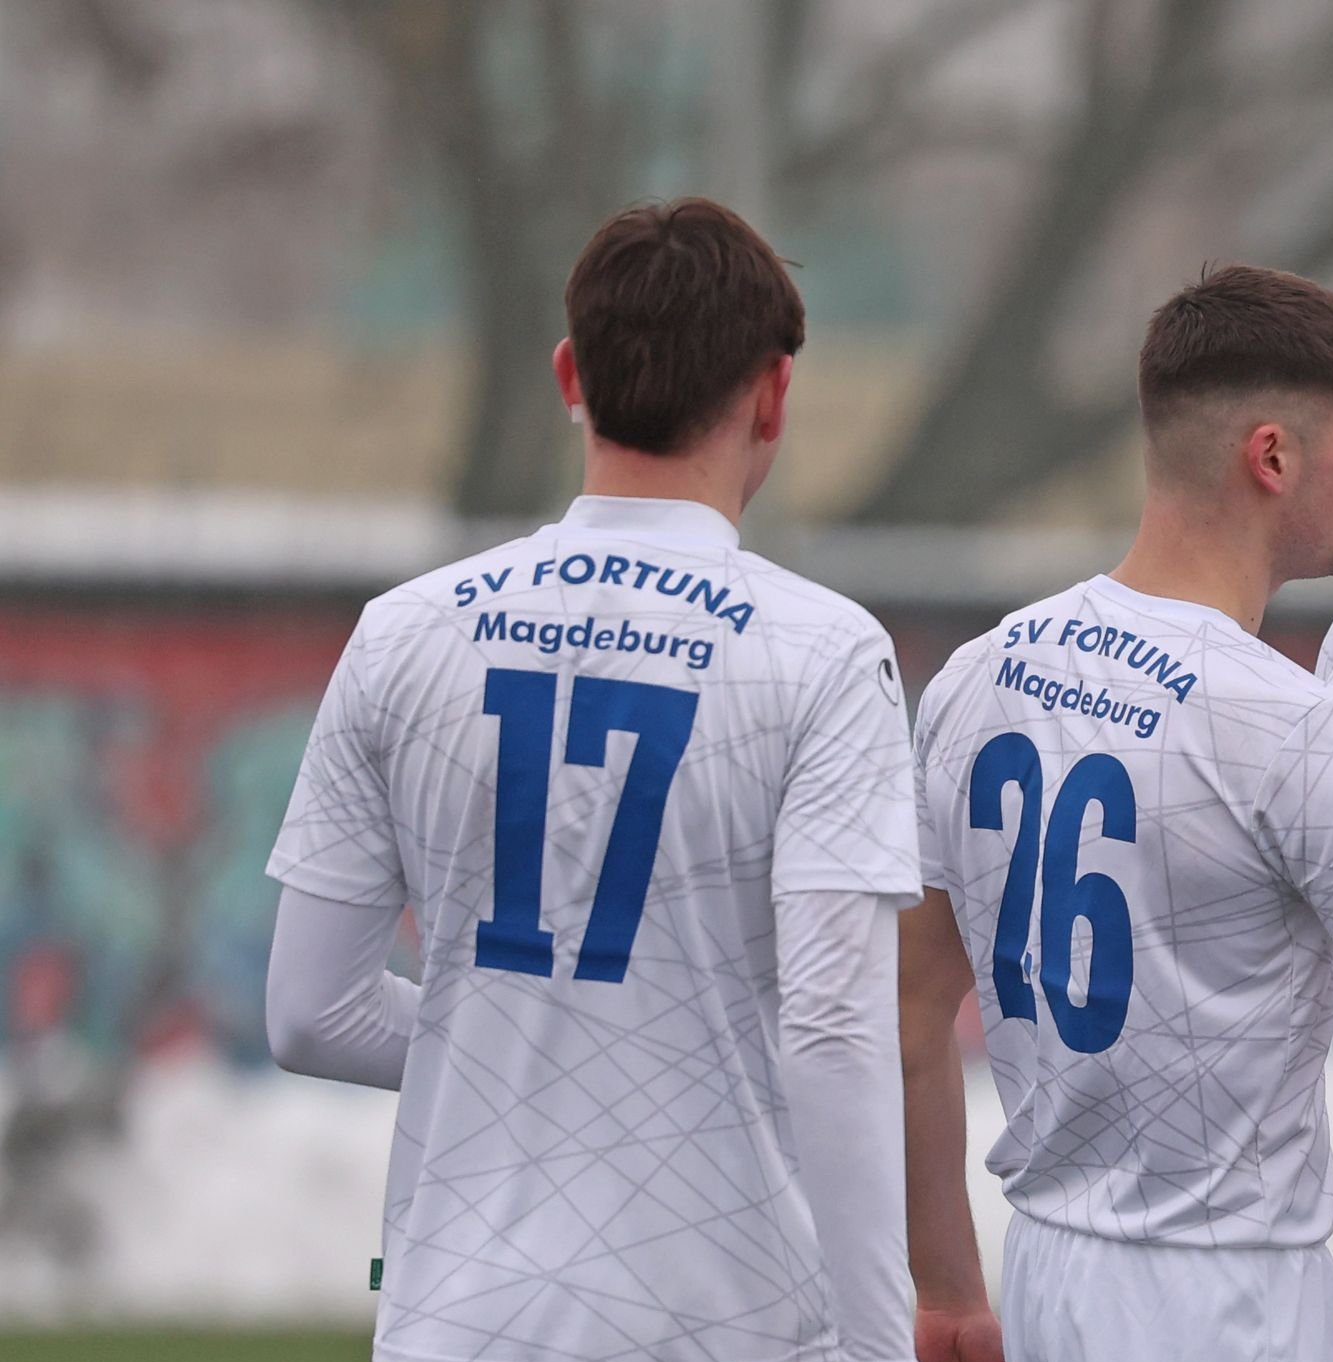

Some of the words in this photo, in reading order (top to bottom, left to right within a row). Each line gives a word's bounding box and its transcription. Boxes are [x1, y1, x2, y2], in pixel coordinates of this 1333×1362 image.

[454, 567, 514, 607] SV
[532, 554, 755, 635] FORTUNA
[473, 611, 715, 670] Magdeburg
[1003, 617, 1054, 649] SV
[1058, 619, 1198, 705] FORTUNA
[995, 657, 1162, 739] Magdeburg
[474, 667, 700, 984] 17
[969, 732, 1137, 1054] 26
